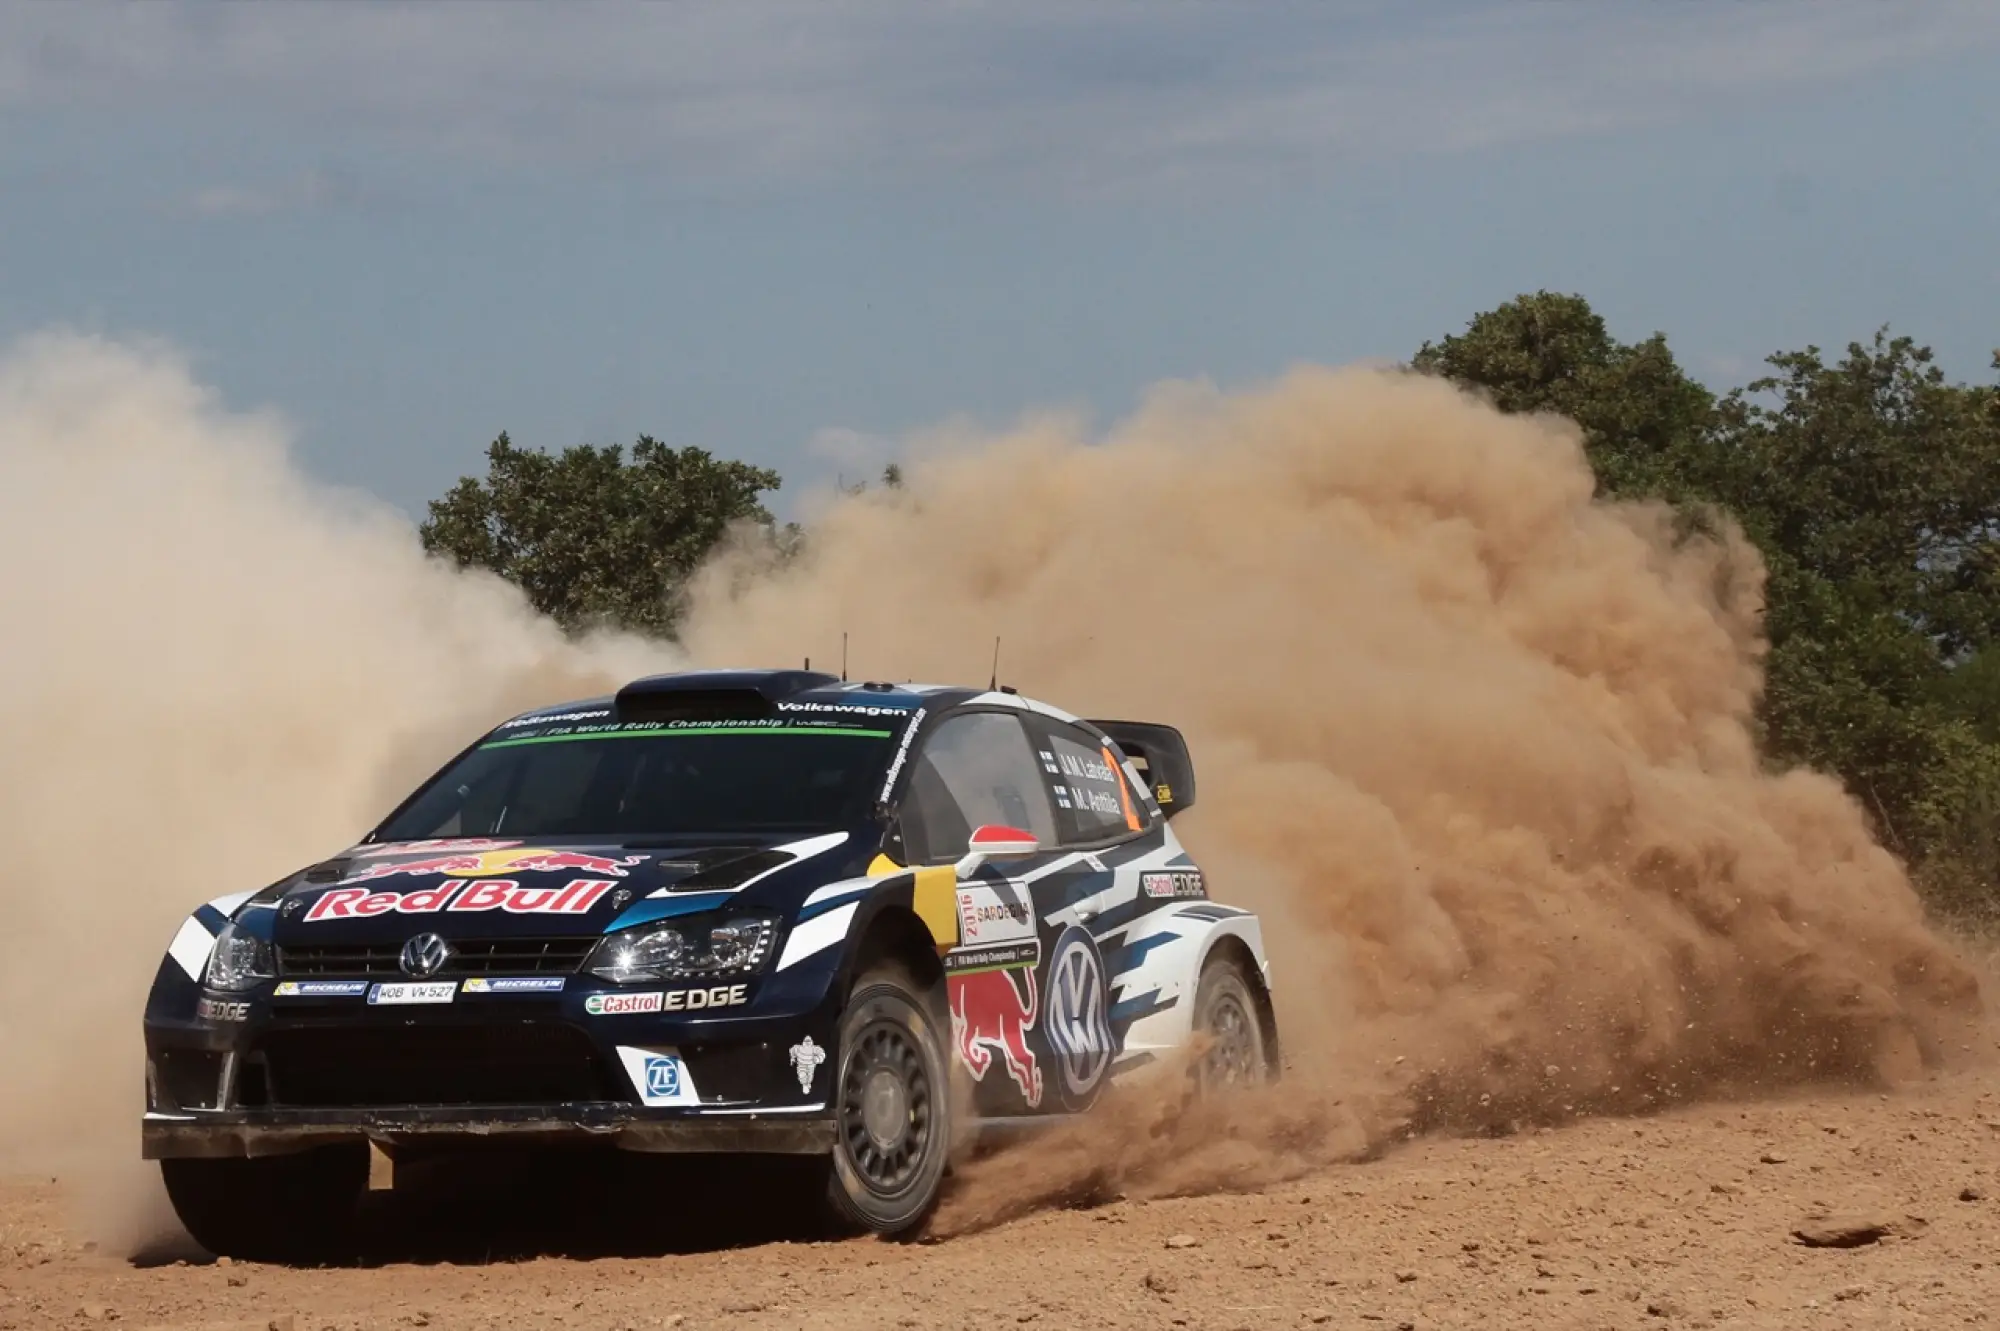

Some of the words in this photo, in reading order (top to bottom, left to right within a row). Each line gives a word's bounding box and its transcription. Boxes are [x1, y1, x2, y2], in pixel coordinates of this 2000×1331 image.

[777, 702, 907, 717] Volkswagen
[546, 727, 572, 736] FIA
[576, 723, 622, 733] World
[624, 720, 664, 730] Rally
[668, 718, 783, 729] Championship
[1174, 873, 1204, 896] EDGE
[303, 880, 461, 922] Red
[447, 880, 619, 914] Bull
[302, 983, 365, 993] MICHELIN
[380, 986, 404, 999] WOB
[411, 986, 428, 998] VW
[428, 985, 454, 998] 527
[492, 979, 561, 989] MICHELIN
[603, 994, 659, 1013] Castrol
[663, 983, 748, 1011] EDGE
[211, 1001, 252, 1021] EDGE
[648, 1066, 677, 1089] ZF
